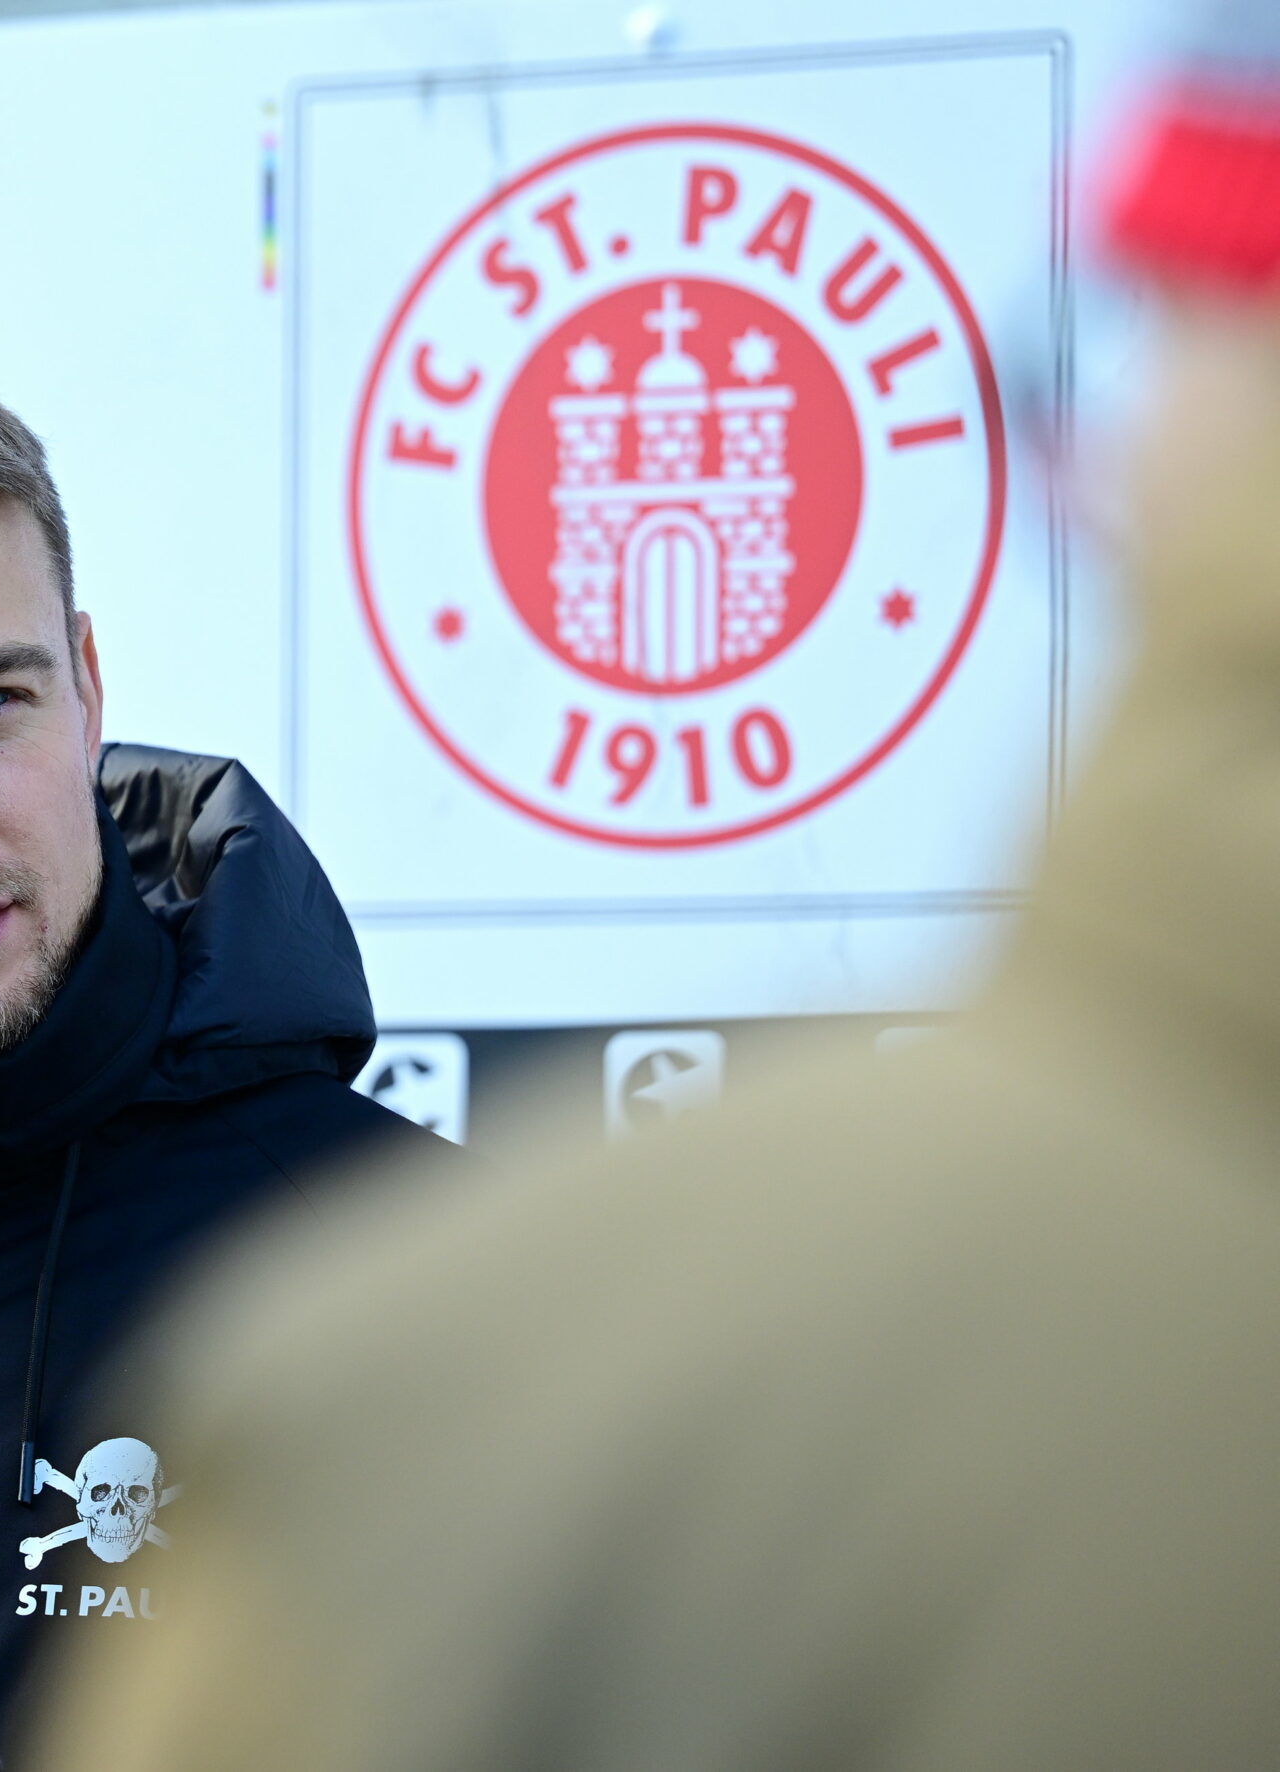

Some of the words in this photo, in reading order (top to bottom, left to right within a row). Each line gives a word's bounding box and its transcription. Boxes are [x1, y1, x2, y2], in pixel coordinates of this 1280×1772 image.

[389, 344, 480, 467] FC
[483, 193, 629, 315] ST.
[684, 164, 963, 450] PAULI
[550, 708, 792, 807] 1910
[16, 1584, 67, 1616] ST.
